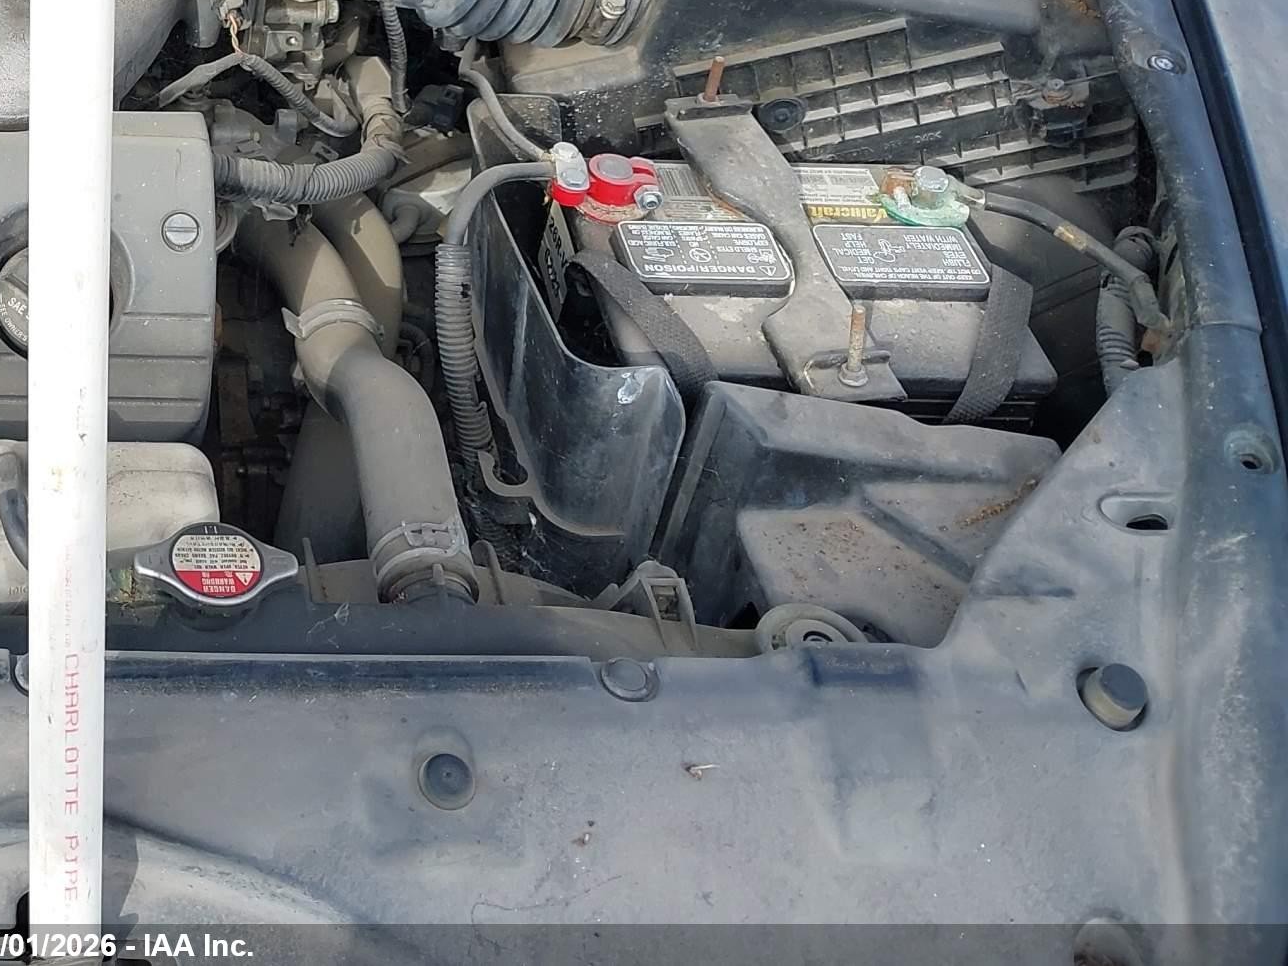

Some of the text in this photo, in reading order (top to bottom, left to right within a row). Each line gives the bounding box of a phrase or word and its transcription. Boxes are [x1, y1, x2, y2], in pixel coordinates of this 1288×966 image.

[809, 206, 887, 222] Valucraft
[903, 234, 959, 243] WITH WATER
[905, 242, 962, 251] IMMEDIATELY
[832, 248, 872, 256] MEDICAL
[857, 256, 874, 264] GET
[942, 258, 970, 267] FLUSH
[644, 264, 756, 274] DANGER/POISON
[7, 296, 27, 315] SAE
[63, 652, 80, 817] CHARLOTTE
[63, 834, 79, 902] PIPE
